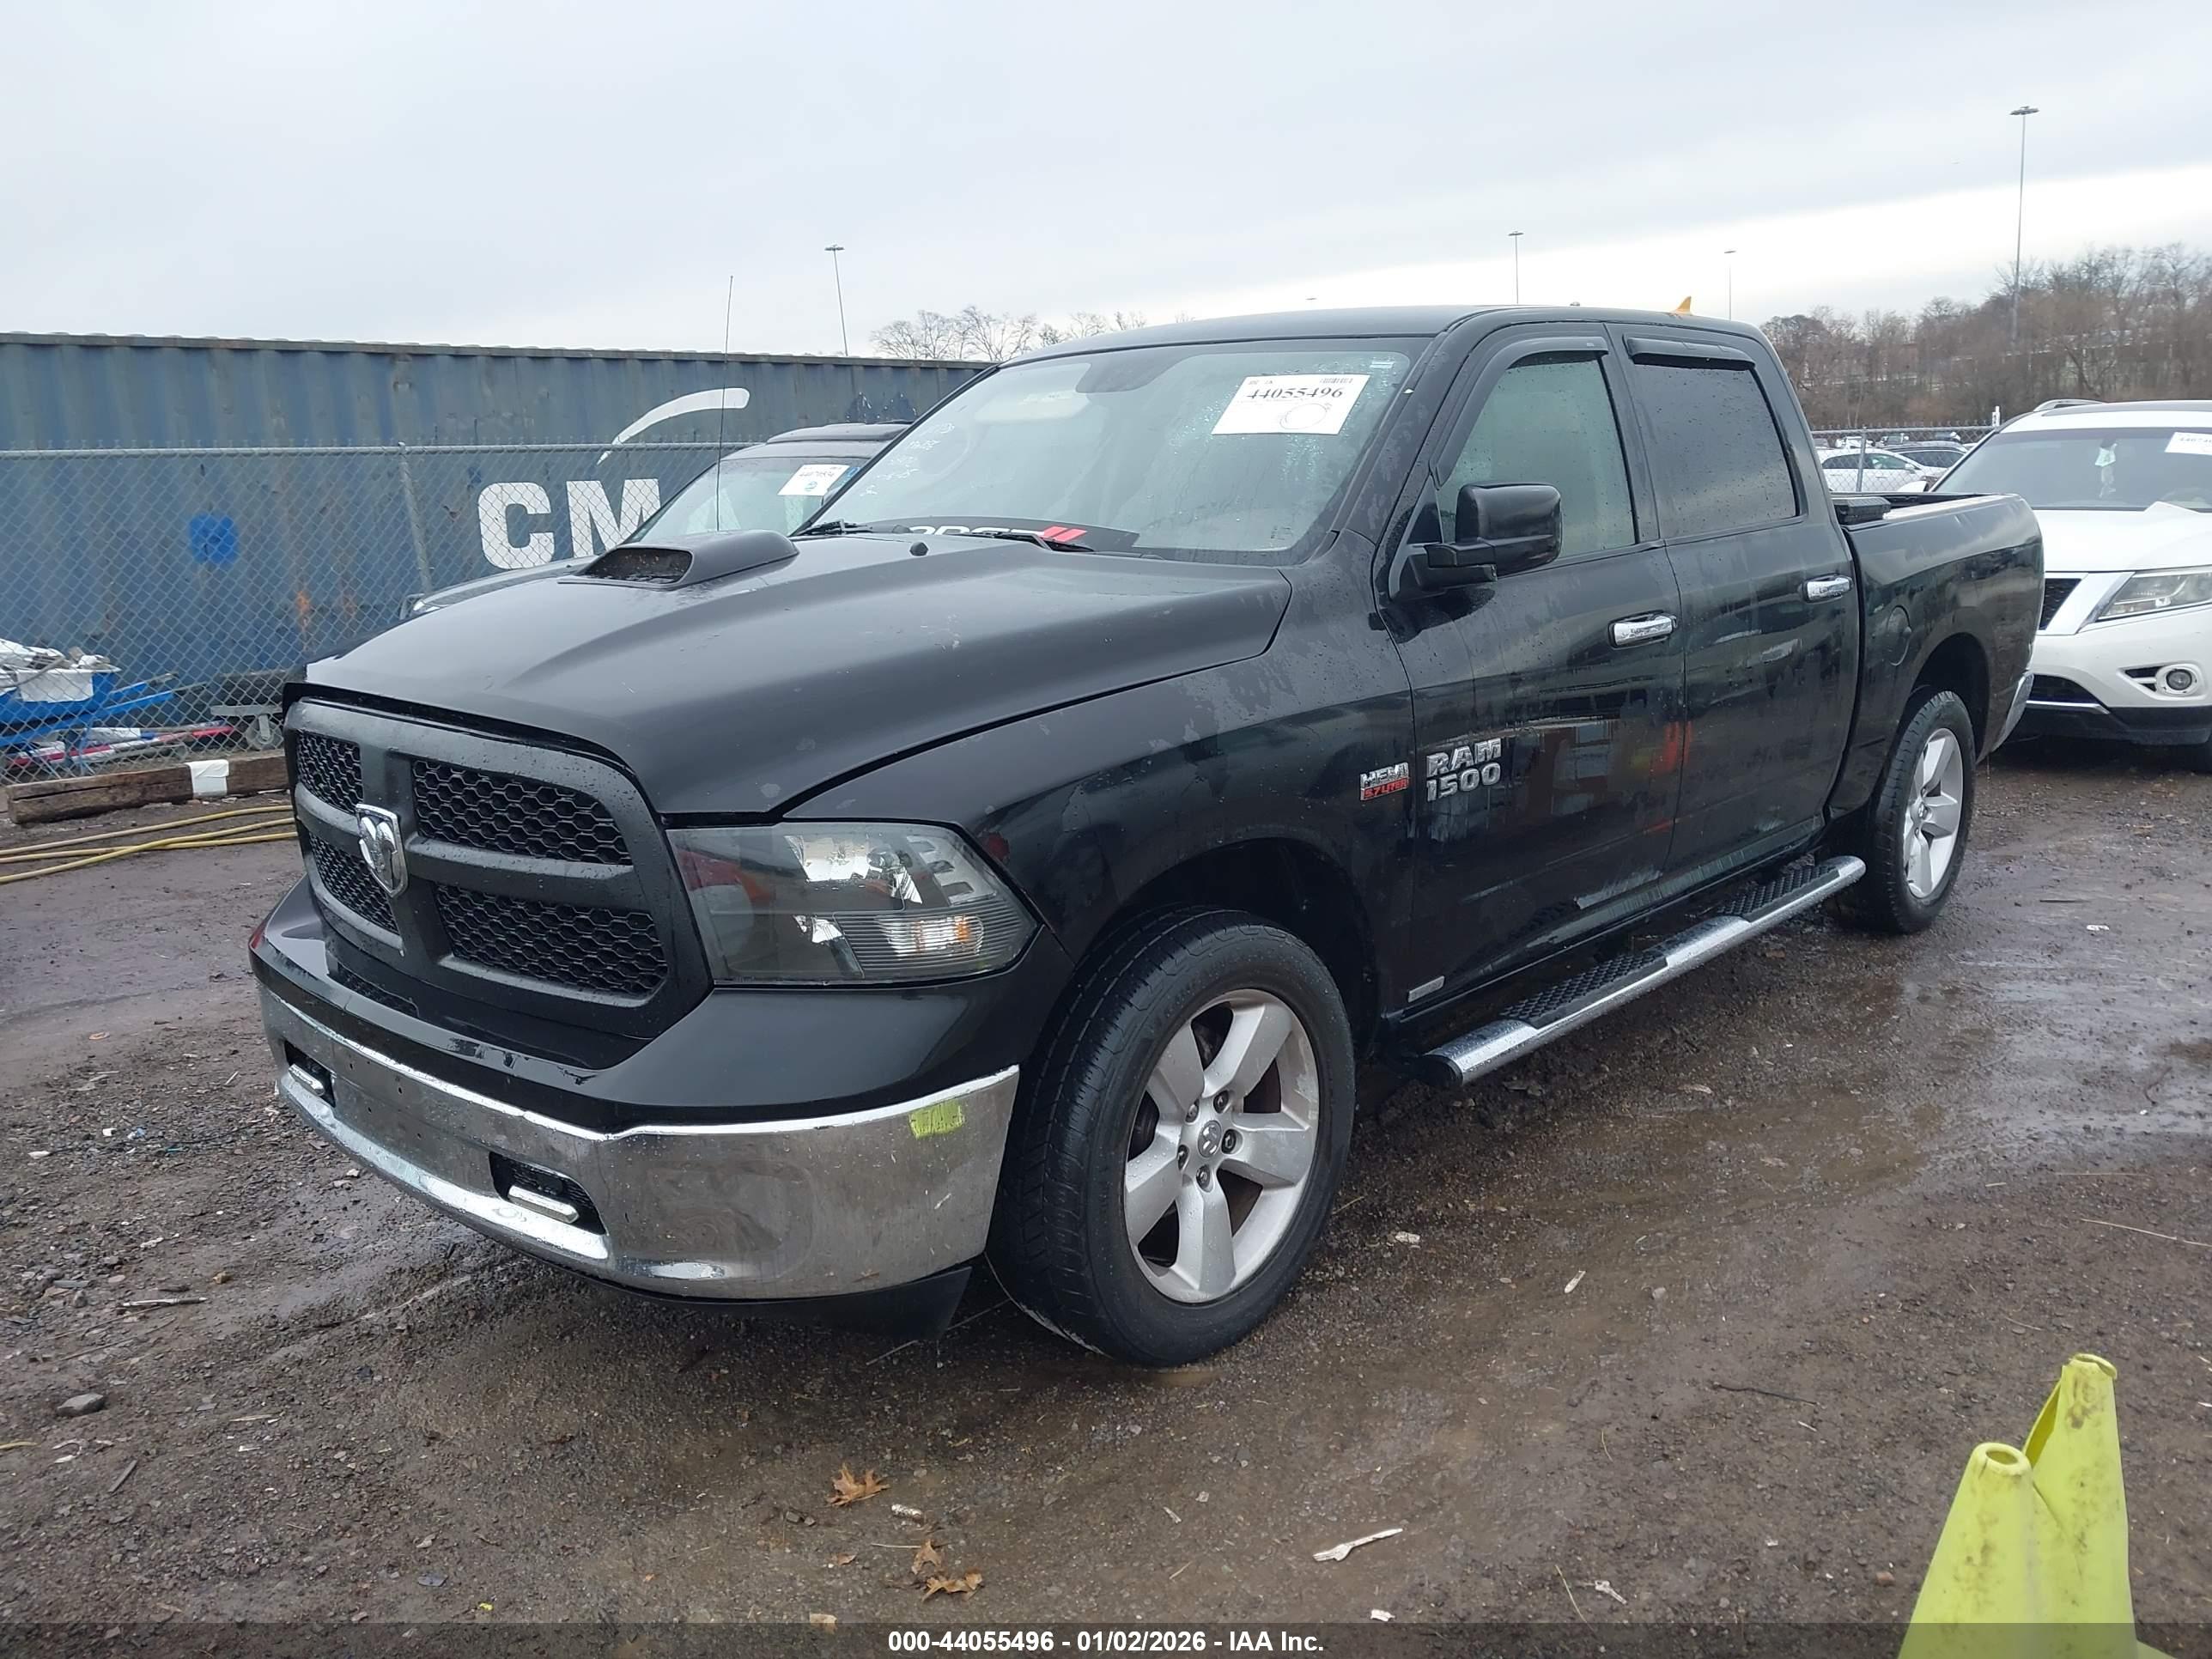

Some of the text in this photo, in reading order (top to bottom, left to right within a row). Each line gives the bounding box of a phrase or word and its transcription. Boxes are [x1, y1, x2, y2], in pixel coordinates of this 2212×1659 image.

[1246, 386, 1345, 399] 44055496
[1426, 737, 1502, 778] RAM
[1425, 762, 1502, 803] 1500
